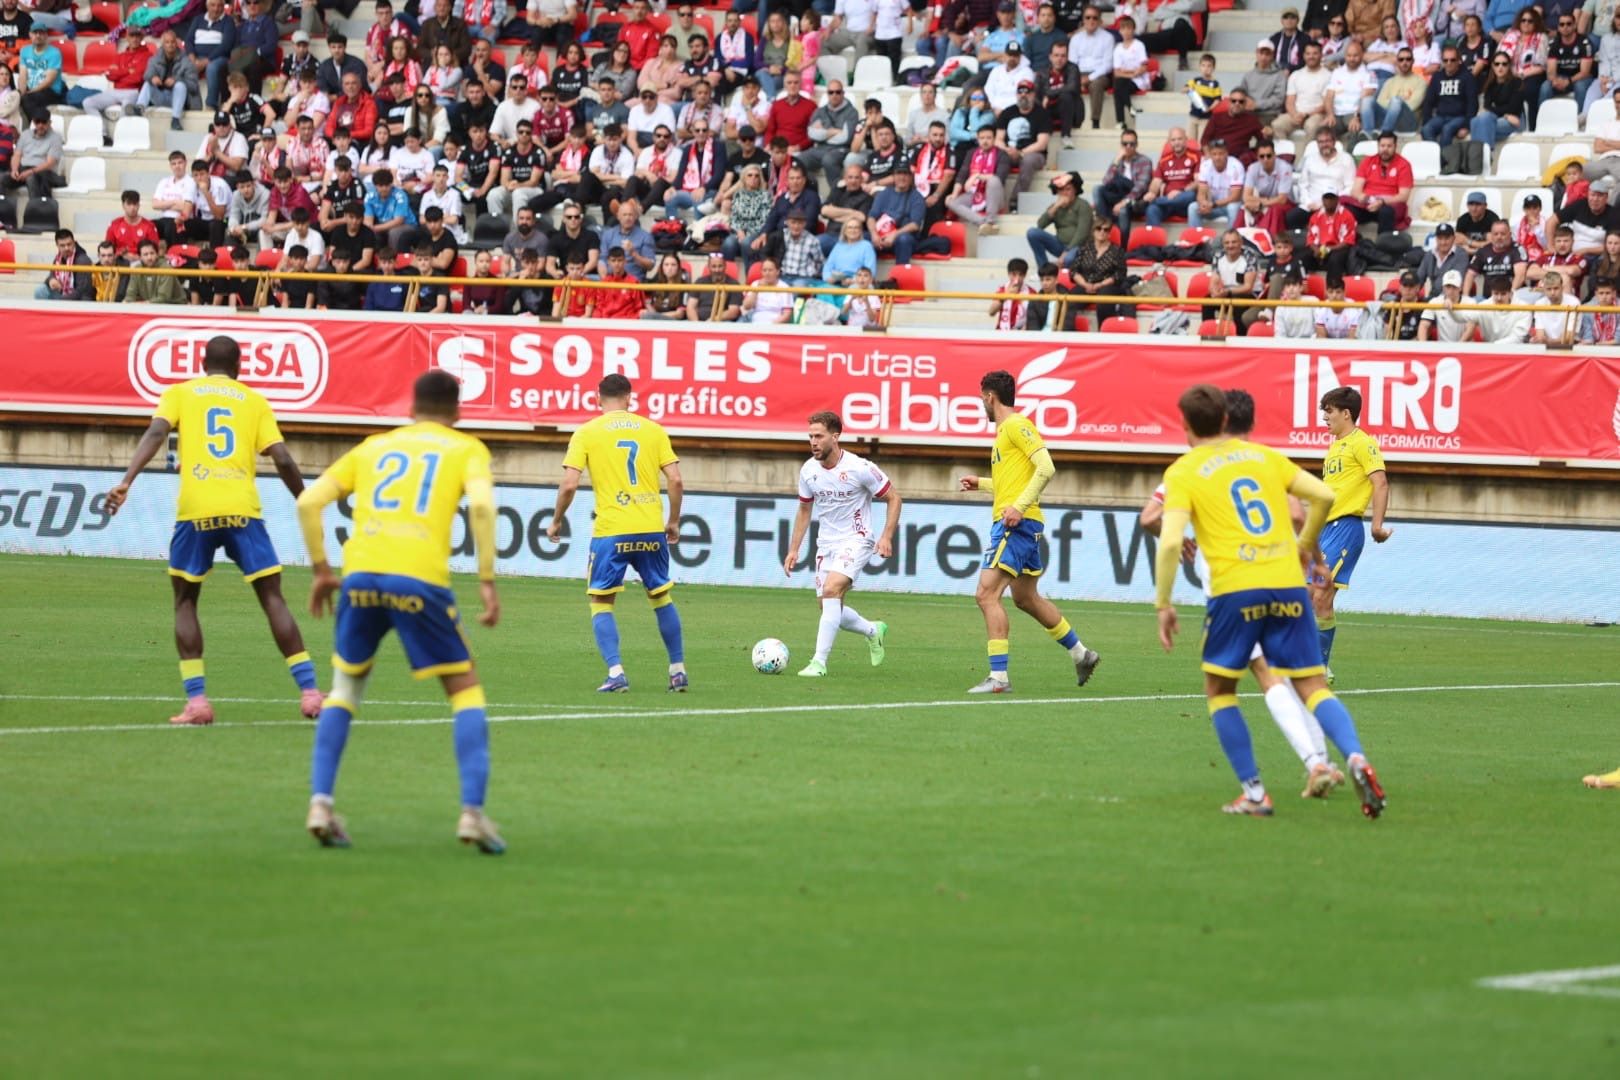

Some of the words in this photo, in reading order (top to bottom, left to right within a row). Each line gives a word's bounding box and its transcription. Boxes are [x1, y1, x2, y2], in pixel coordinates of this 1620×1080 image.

[145, 338, 305, 391] CEESA
[509, 332, 772, 384] SORLES
[800, 344, 937, 378] Frutas
[509, 383, 639, 411] servics
[647, 388, 767, 419] gráficos
[842, 380, 890, 430] el
[900, 381, 1077, 436] biezo
[205, 406, 236, 460] 5
[1080, 423, 1117, 433] grupo
[372, 451, 440, 515] 21
[616, 439, 640, 486] 7
[812, 490, 854, 498] ASPIRE
[1230, 477, 1273, 535] 6
[191, 516, 249, 531] TELENO
[615, 541, 661, 553] TELENO
